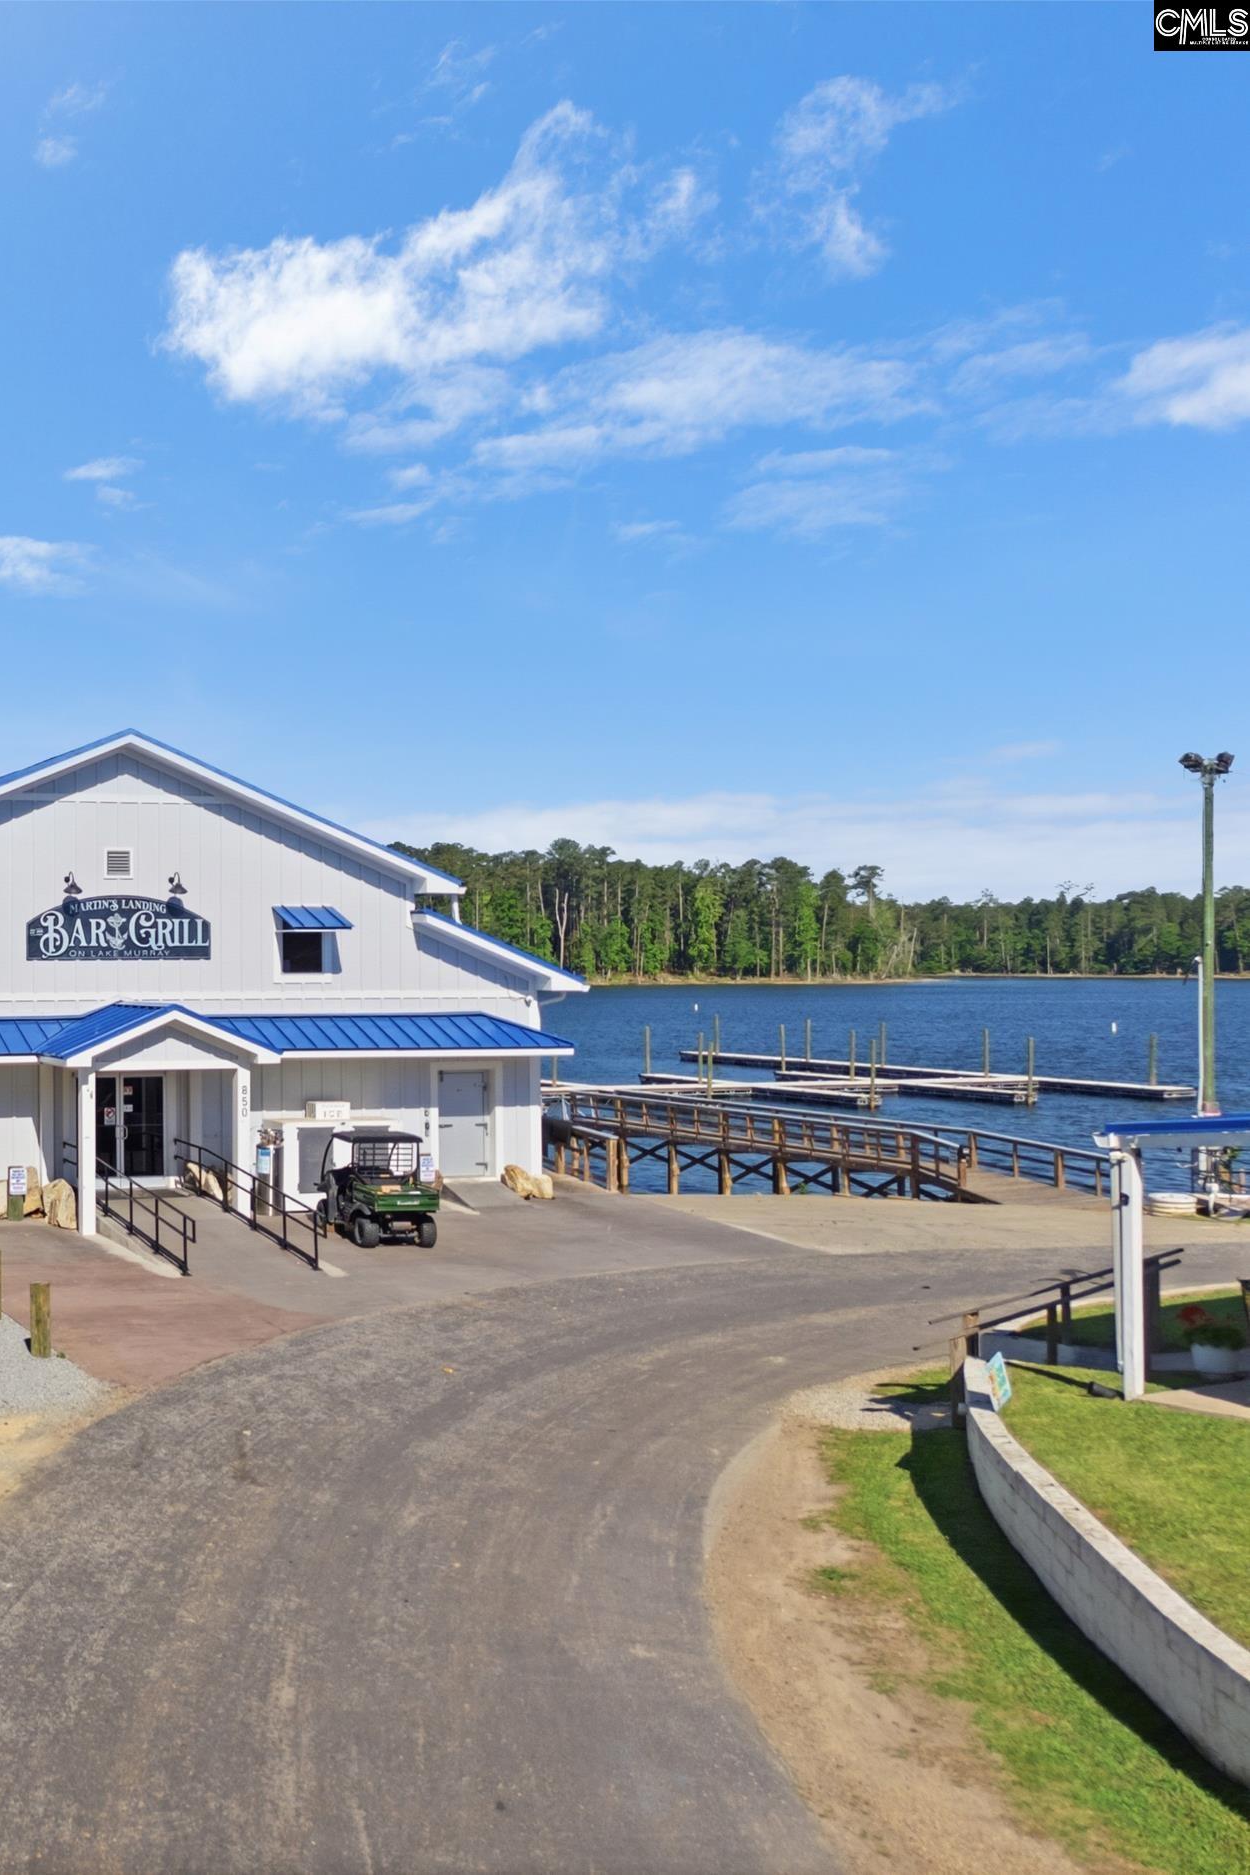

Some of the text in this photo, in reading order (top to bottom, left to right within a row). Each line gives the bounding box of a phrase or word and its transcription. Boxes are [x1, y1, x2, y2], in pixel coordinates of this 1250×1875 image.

[69, 899, 167, 914] MARTIN'S LANDING
[39, 910, 210, 959] BAR GRILL
[68, 949, 171, 957] ON LAKE MURRAY
